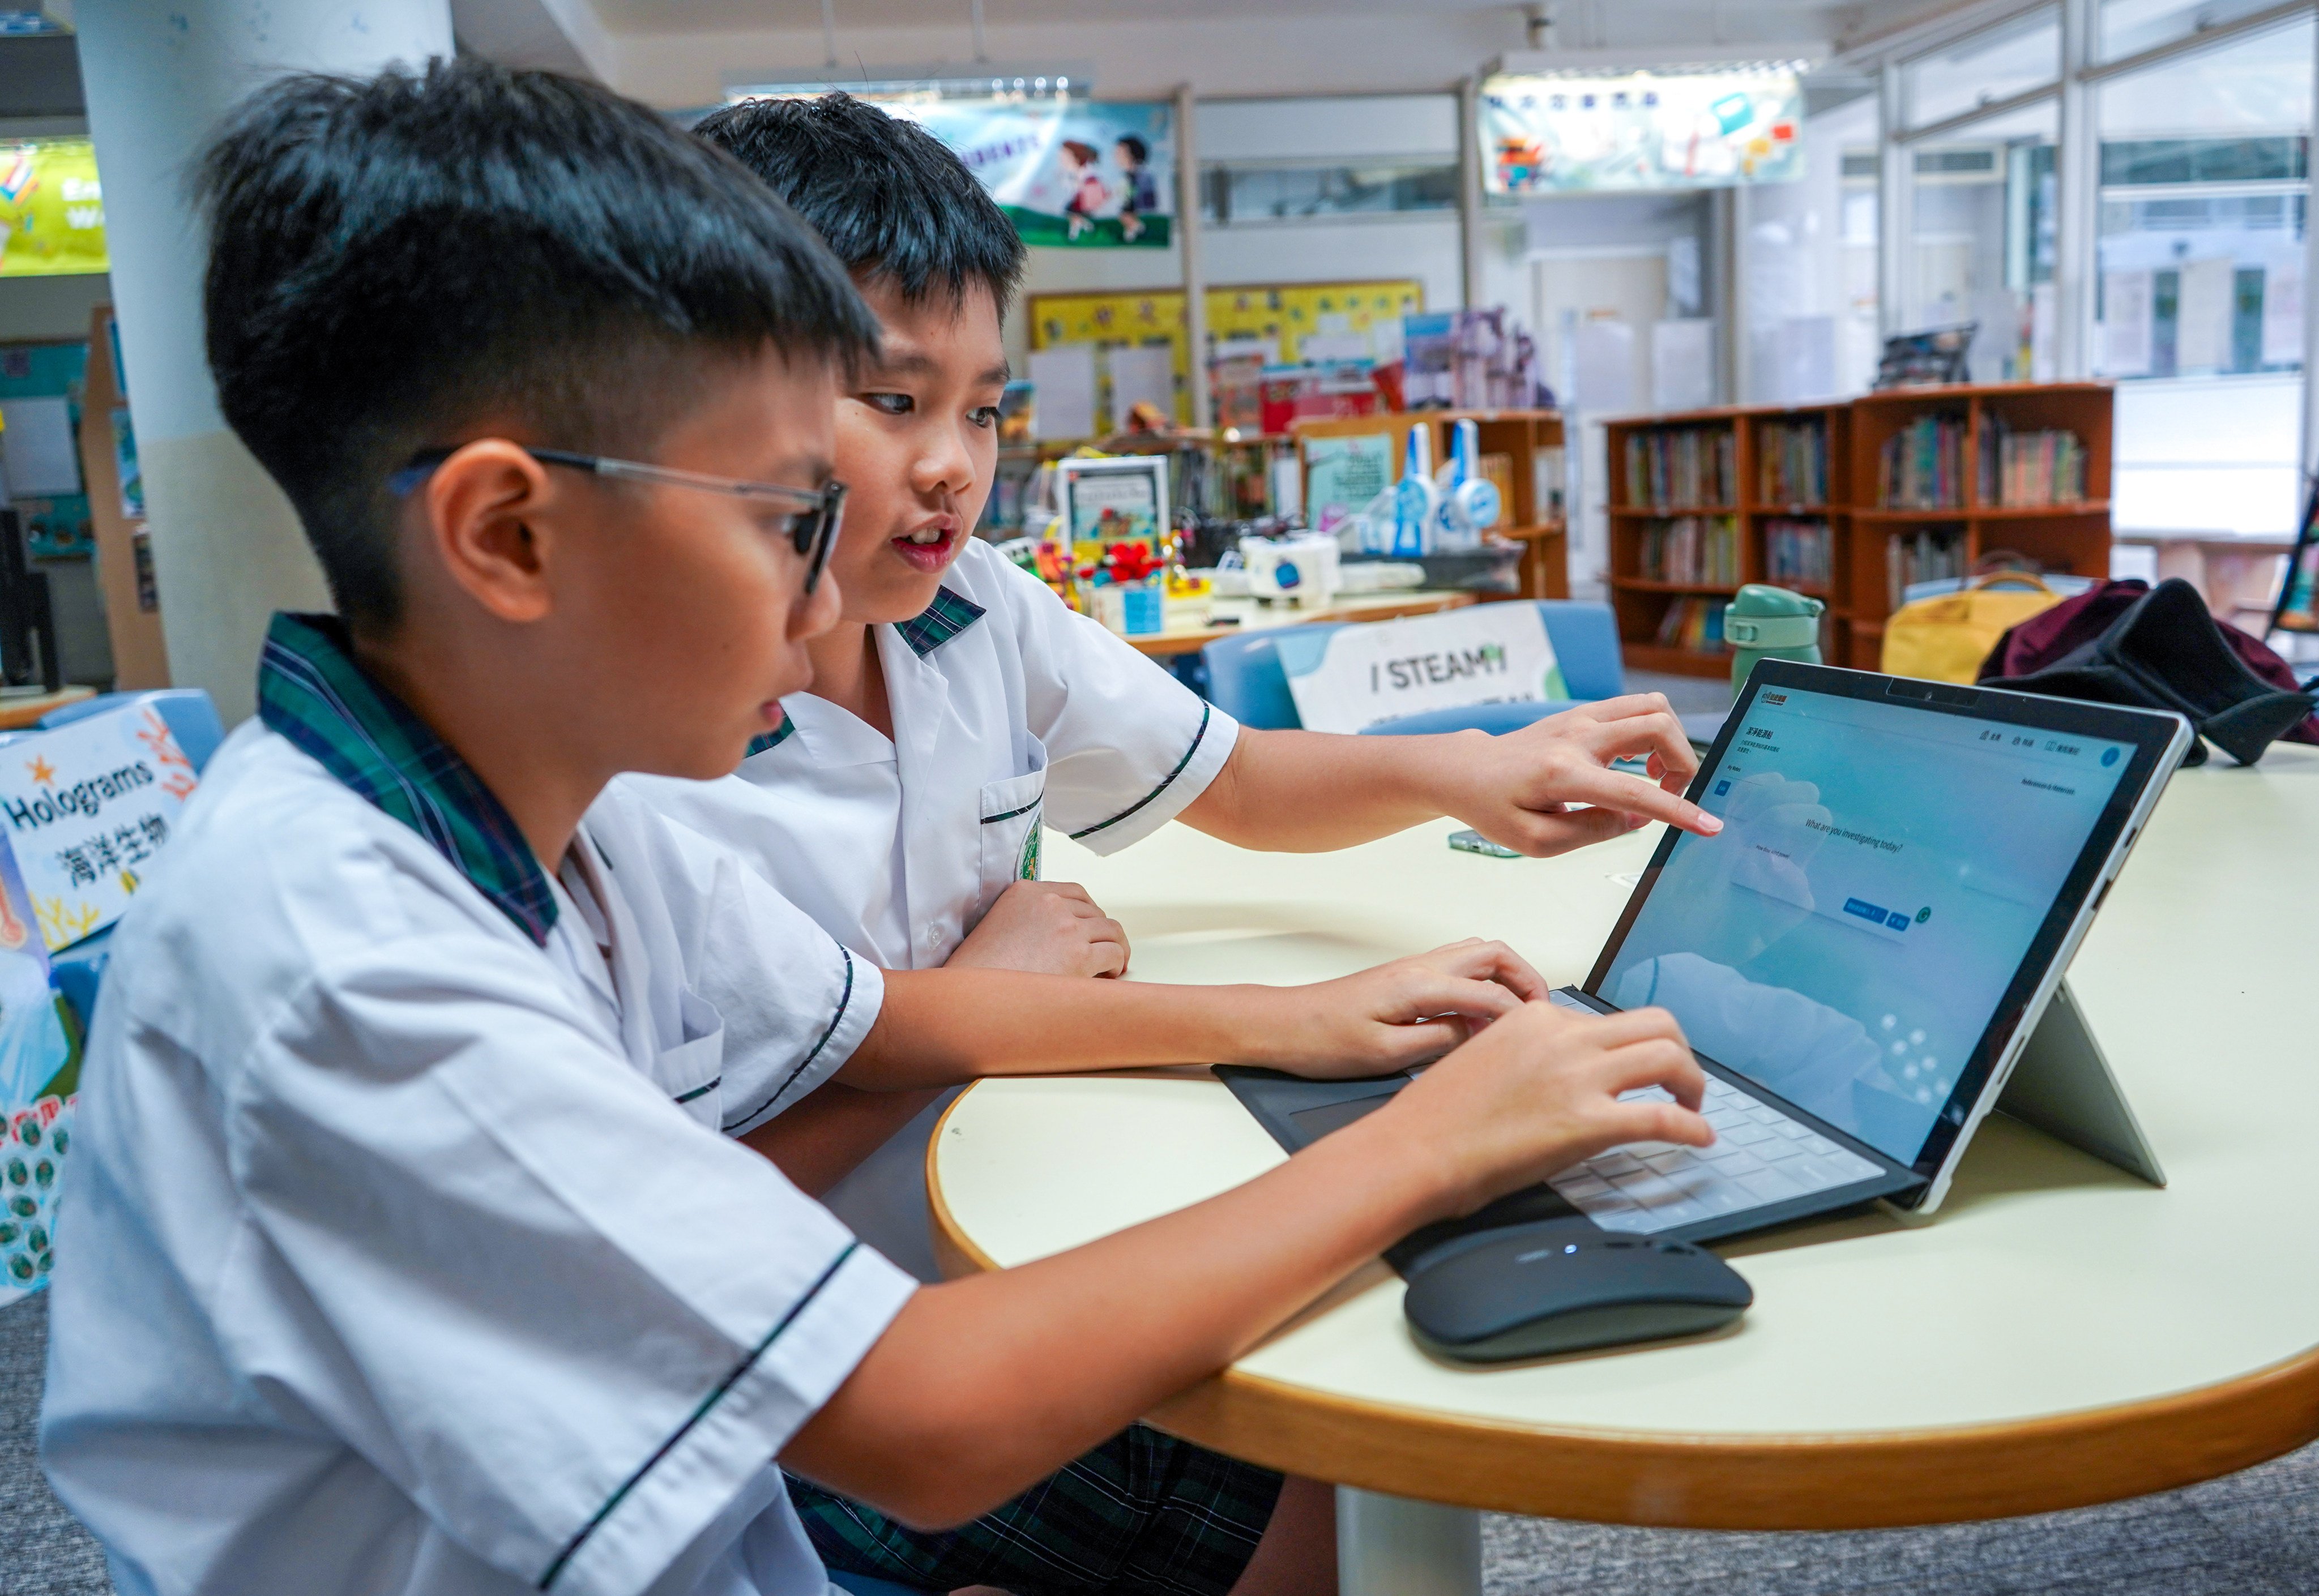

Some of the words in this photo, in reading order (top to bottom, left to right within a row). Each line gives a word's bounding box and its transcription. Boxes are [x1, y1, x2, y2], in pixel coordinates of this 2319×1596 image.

[1388, 649, 1493, 690] STEAM
[3, 760, 154, 828] Holograms
[57, 812, 167, 889] 海洋生物
[1805, 819, 1820, 830] What
[1842, 828, 1881, 849] investigating
[1880, 840, 1903, 853] today?
